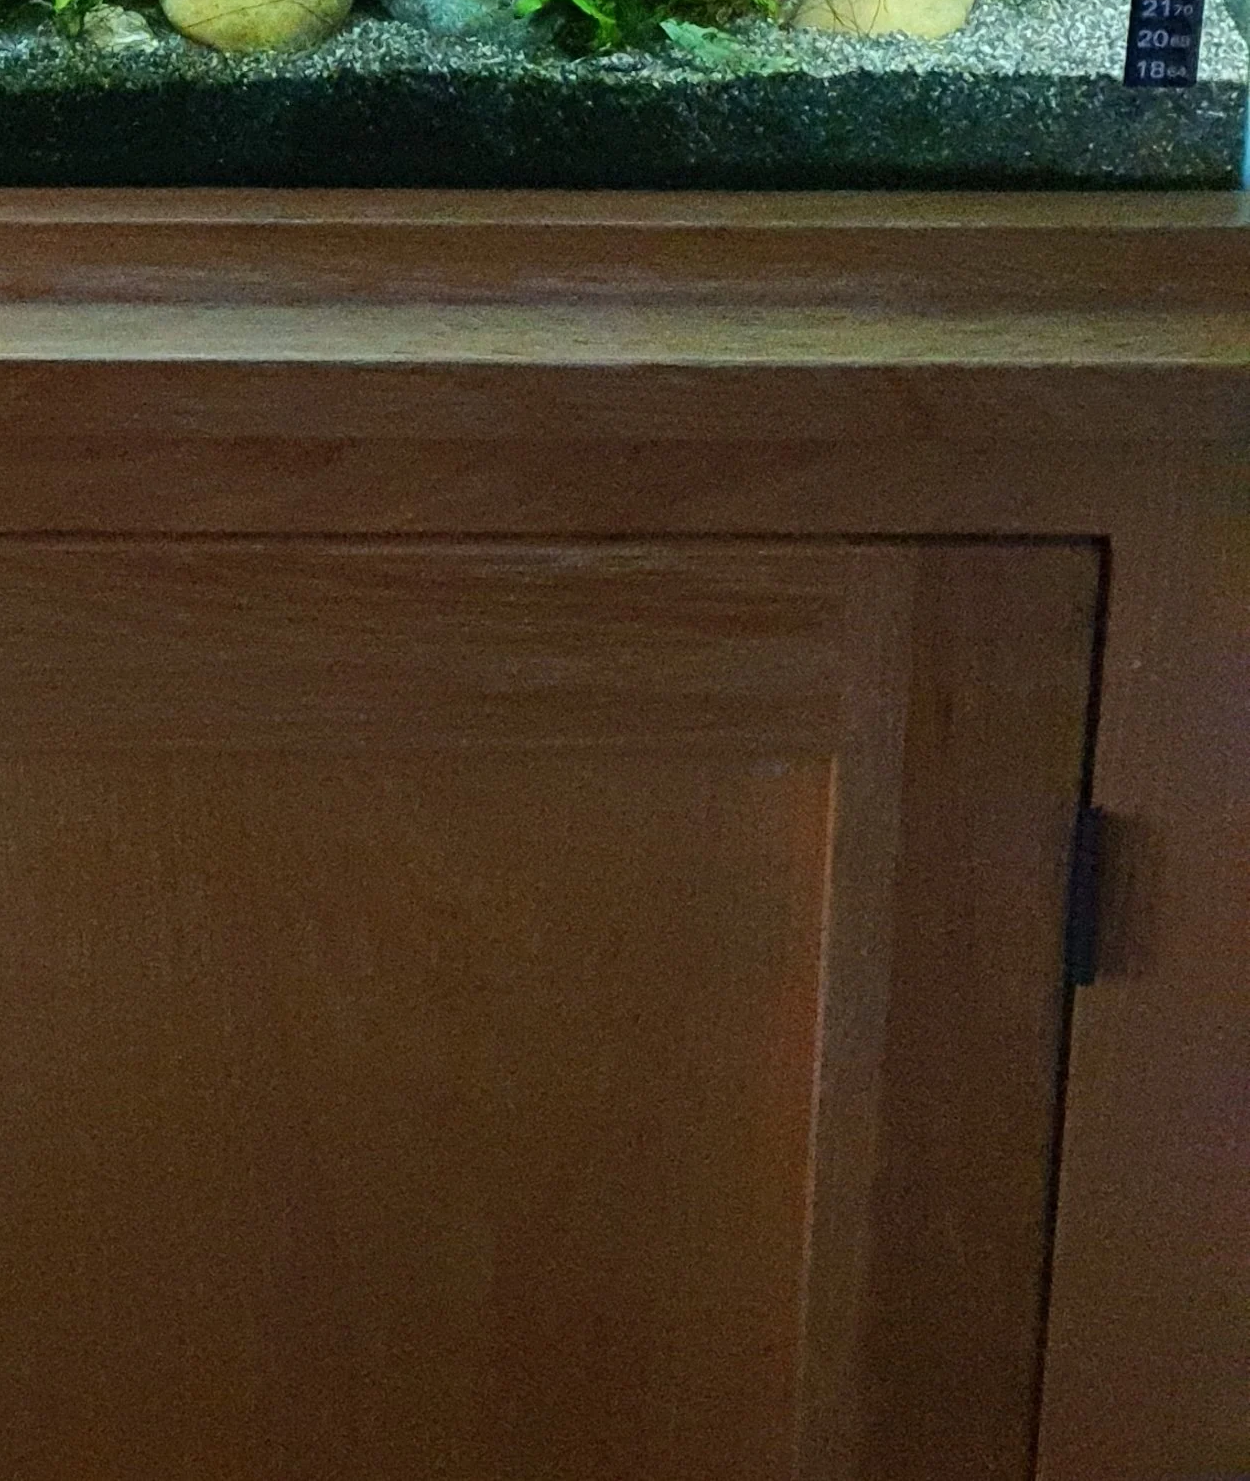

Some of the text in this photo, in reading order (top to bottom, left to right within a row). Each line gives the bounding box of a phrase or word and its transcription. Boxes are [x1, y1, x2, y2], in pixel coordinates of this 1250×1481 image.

[1141, 0, 1193, 17] 21 70
[1137, 30, 1169, 48] 20
[1136, 61, 1165, 78] 18
